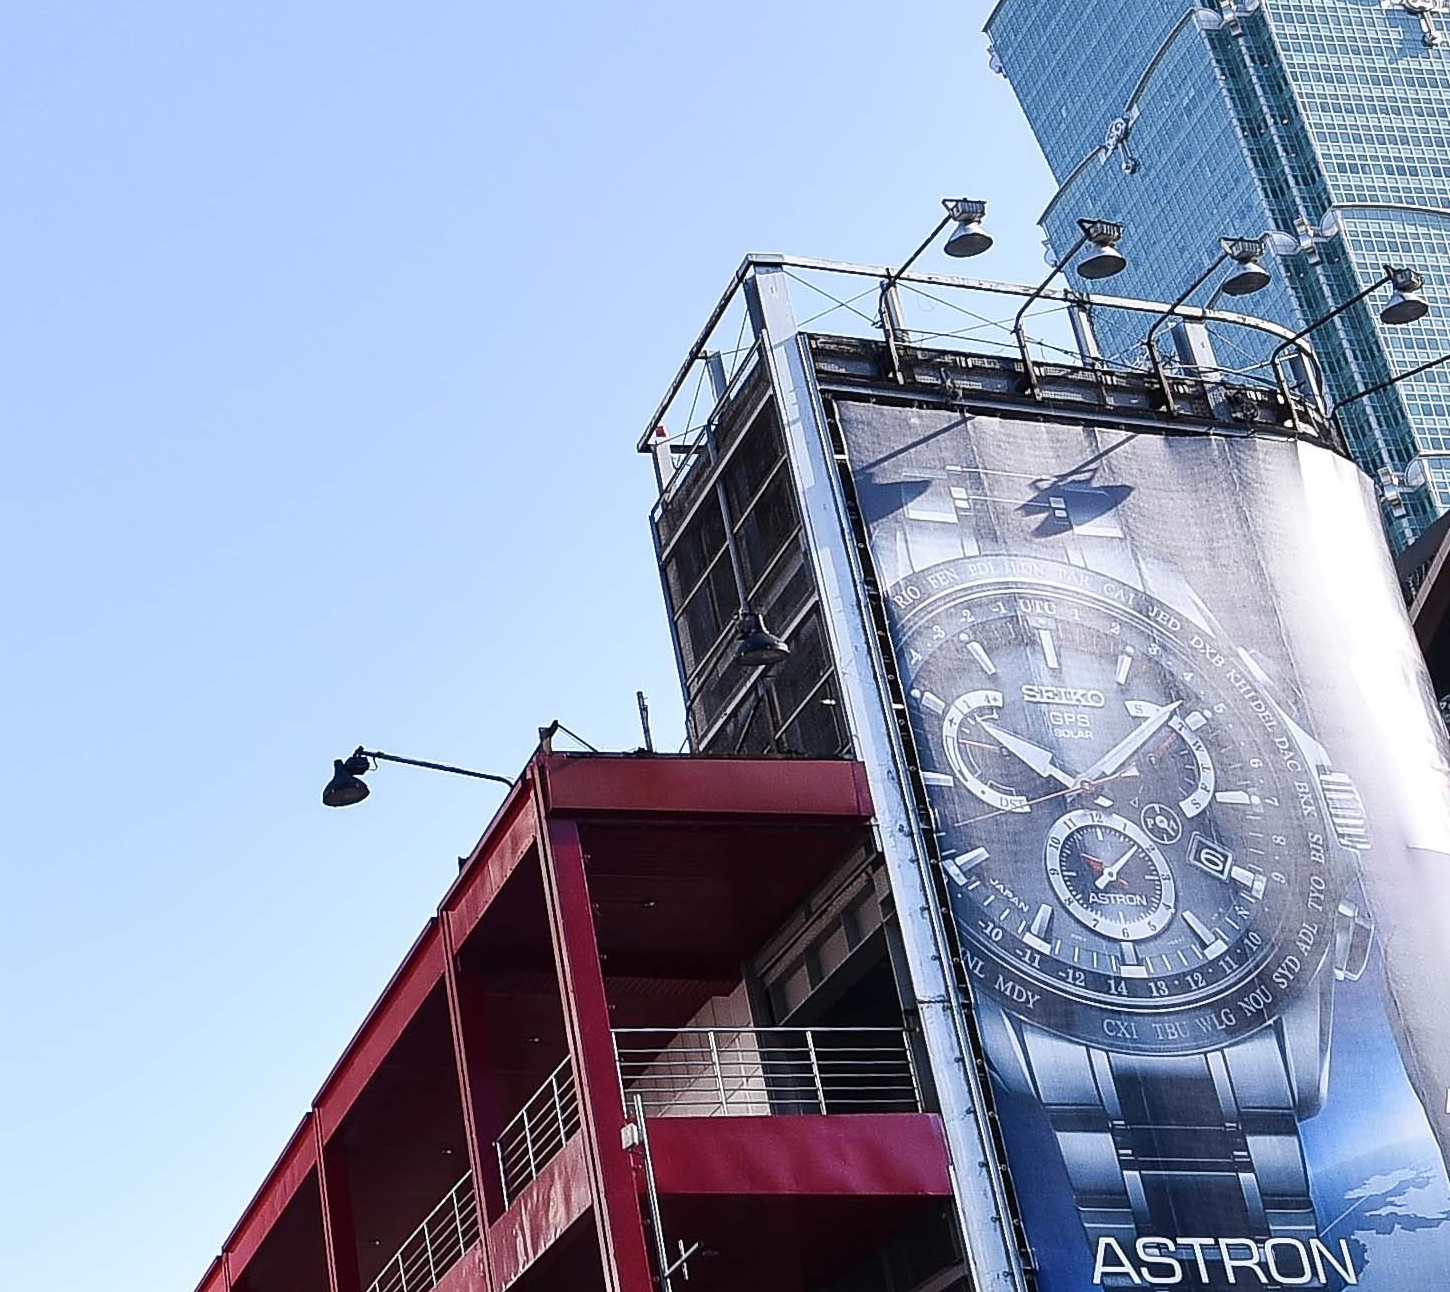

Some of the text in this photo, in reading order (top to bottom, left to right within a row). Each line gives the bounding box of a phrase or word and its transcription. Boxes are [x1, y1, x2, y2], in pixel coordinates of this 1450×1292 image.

[893, 586, 920, 609] RIO
[1018, 598, 1056, 615] UTC
[1103, 582, 1136, 607] CAI
[1190, 636, 1224, 667] DXB
[1022, 685, 1106, 707] SEIKO
[1049, 712, 1091, 726] GPS
[1055, 729, 1094, 739] SOLAR
[1274, 736, 1301, 772] DAC
[1295, 780, 1317, 818] BKK
[989, 878, 1030, 912] JAPAN
[1088, 892, 1148, 907] ASTRON
[1308, 876, 1326, 912] TYO
[1298, 923, 1319, 958] ADL
[1273, 956, 1301, 989] SYD
[994, 972, 1041, 1010] MDY
[1238, 987, 1273, 1020] NOU
[1102, 1019, 1138, 1039] CXI
[1152, 1023, 1189, 1040] TBU
[1197, 1007, 1237, 1036] WLG
[1093, 1237, 1357, 1285] ASTRON
